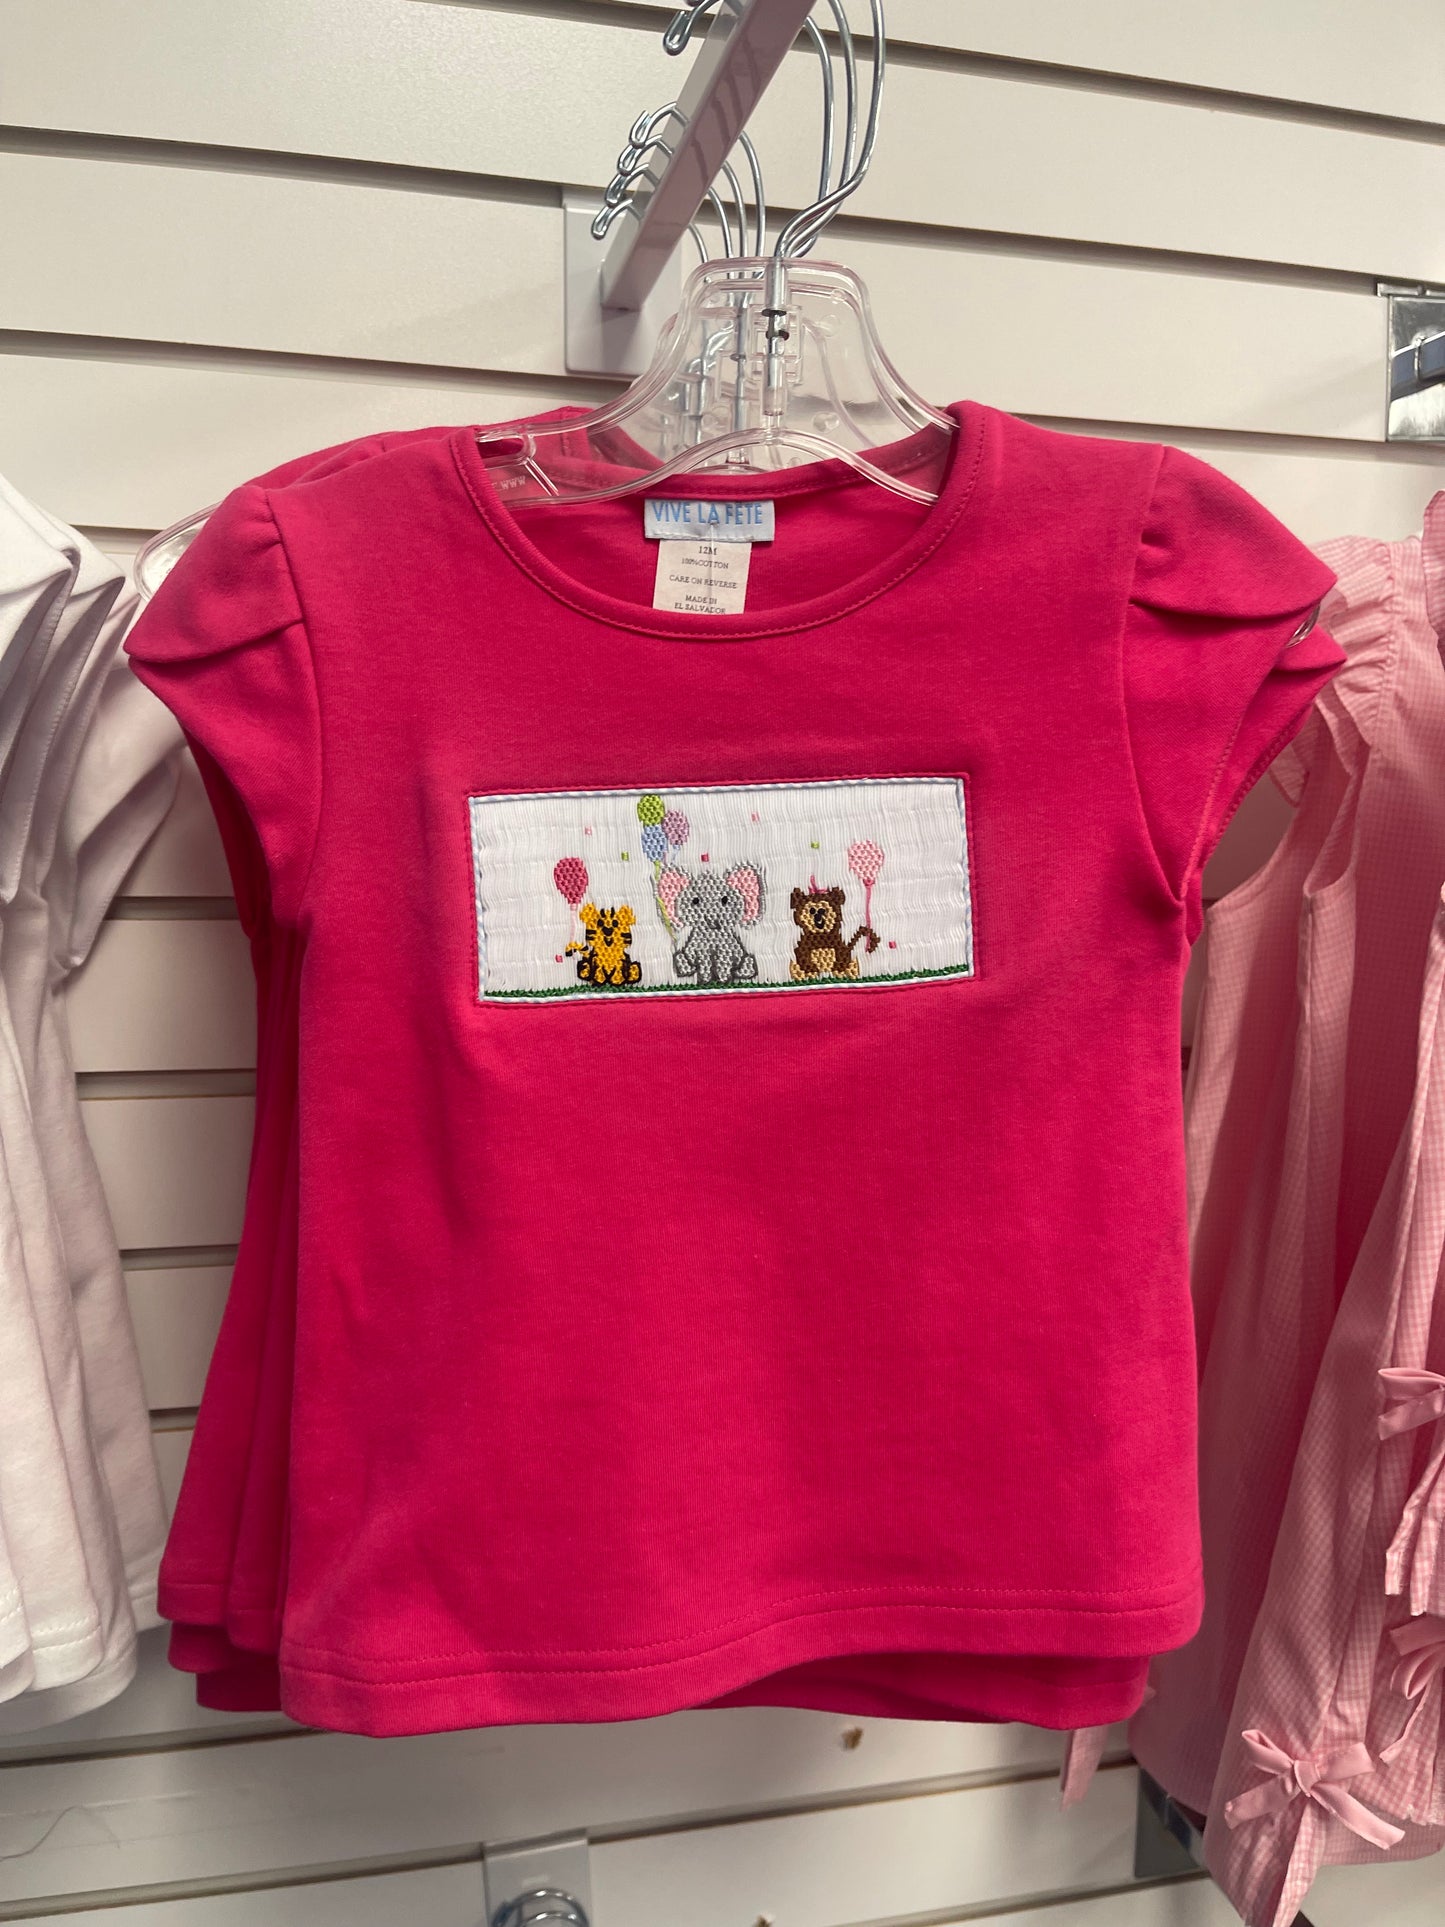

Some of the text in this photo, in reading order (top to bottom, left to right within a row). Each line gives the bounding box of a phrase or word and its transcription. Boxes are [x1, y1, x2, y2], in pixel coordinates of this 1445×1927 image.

[651, 501, 691, 523] VIVE
[698, 502, 720, 524] LA
[698, 545, 718, 556] 12M
[669, 574, 737, 589] CARE ON REVERSE
[685, 594, 718, 605] MADE IN
[674, 602, 726, 614] EL SALVADOR
